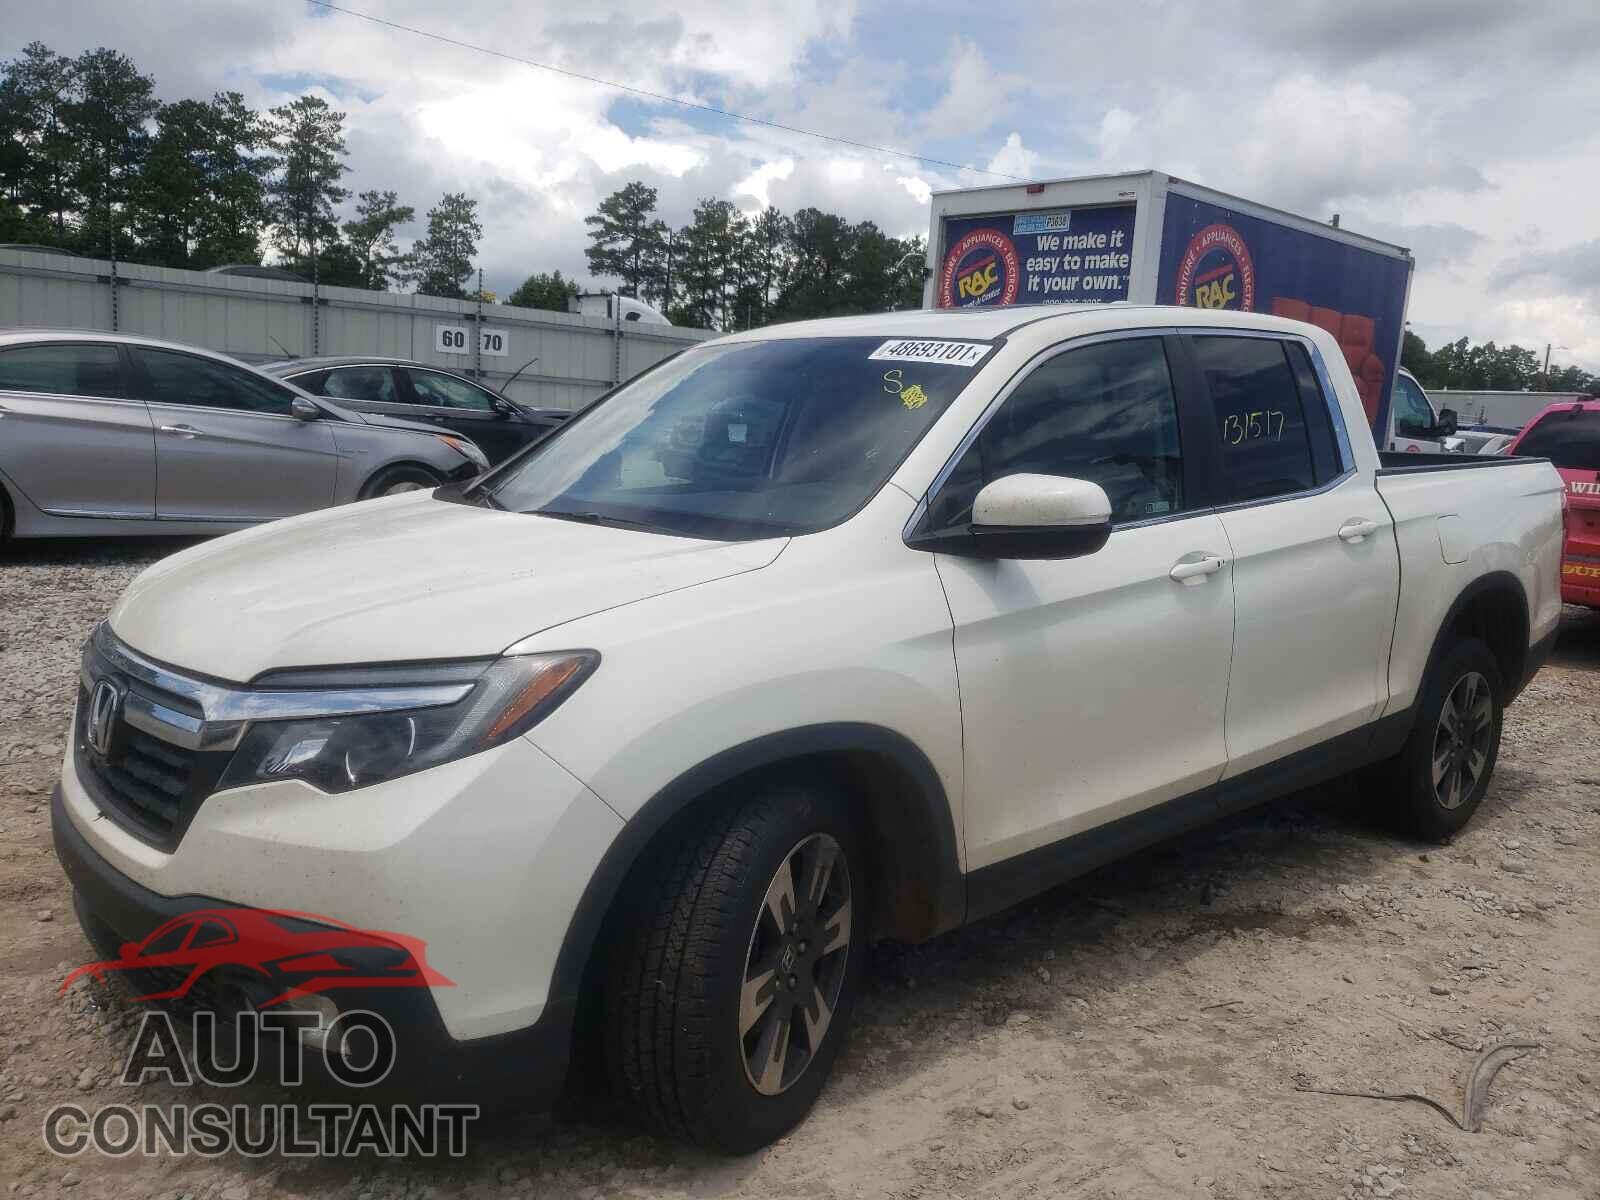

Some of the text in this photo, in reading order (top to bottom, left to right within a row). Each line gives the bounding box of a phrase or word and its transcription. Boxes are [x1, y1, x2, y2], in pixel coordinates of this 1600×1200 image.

[963, 234, 1003, 251] APPLIANCES
[1038, 230, 1124, 251] We make it
[1202, 231, 1241, 255] APPLIANCES
[1026, 252, 1129, 273] easy to make
[959, 262, 998, 298] RAC
[1028, 275, 1122, 293] it your own.
[1196, 274, 1235, 308] RAC
[443, 330, 464, 348] 60
[484, 334, 503, 351] 70
[1223, 410, 1284, 445] 131517
